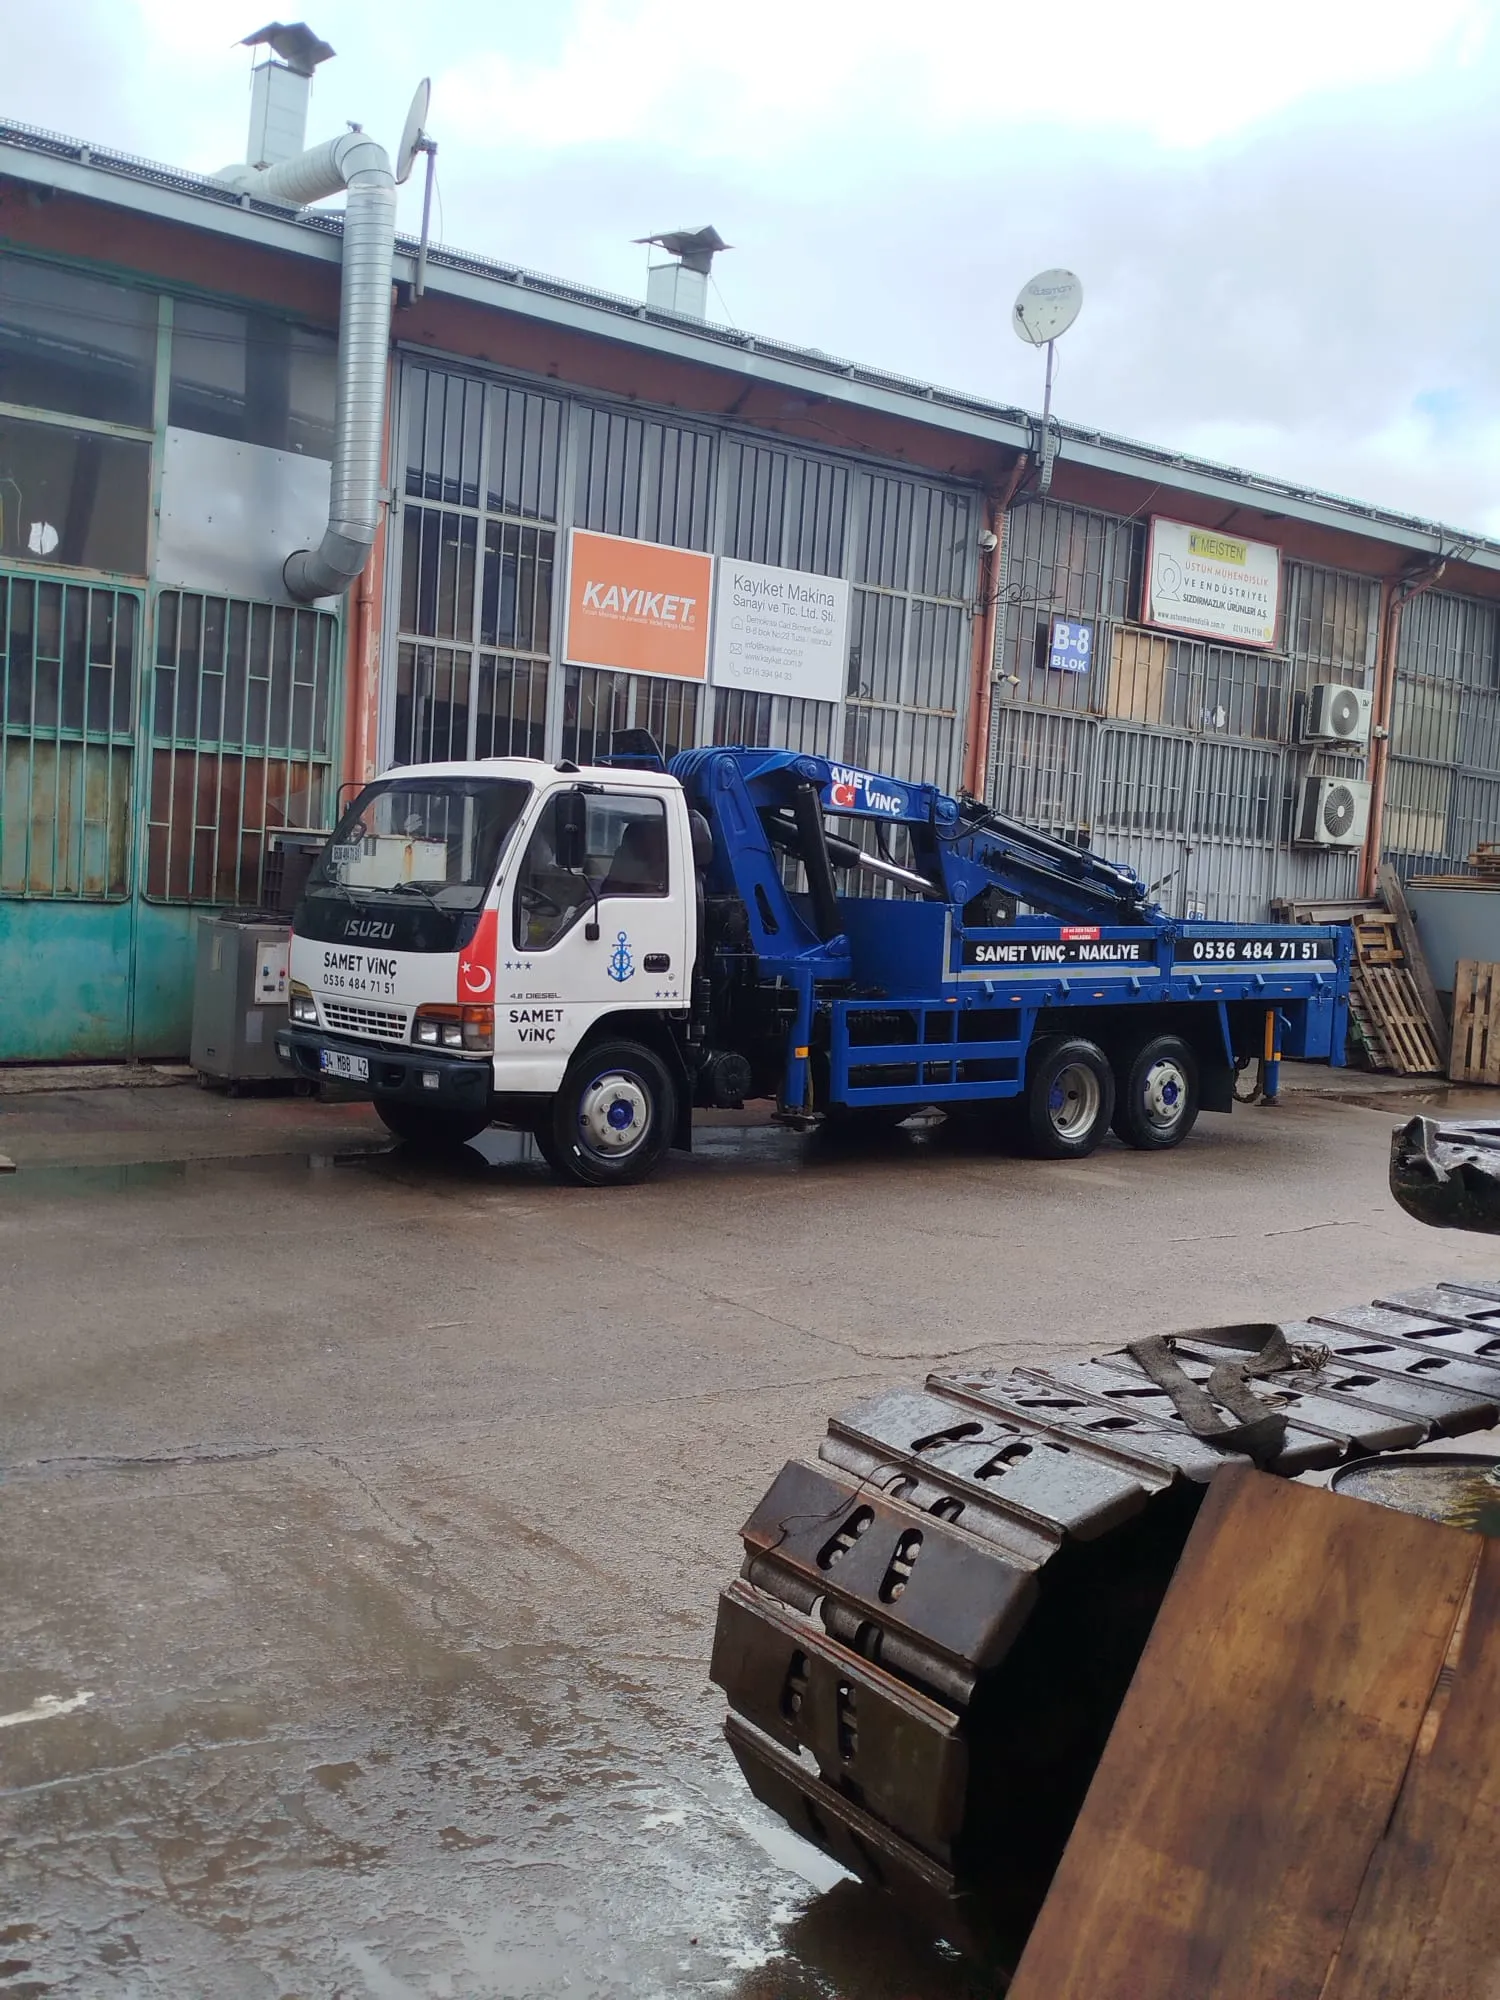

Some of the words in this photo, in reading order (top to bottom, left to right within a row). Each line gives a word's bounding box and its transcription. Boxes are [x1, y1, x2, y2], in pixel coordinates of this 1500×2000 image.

[1184, 577, 1197, 588] VE
[582, 580, 697, 623] KAYIKET
[788, 583, 835, 607] Makina
[733, 594, 765, 612] Sanayi
[768, 603, 779, 613] ve
[782, 602, 798, 617] Tic.
[801, 606, 818, 620] Ltd.
[821, 609, 836, 622] Şti.
[1053, 623, 1090, 654] B-8
[1052, 655, 1088, 671] BLOK
[831, 767, 874, 790] AMET
[344, 919, 395, 939] ISUZU
[975, 945, 1027, 962] SAMET
[1193, 941, 1236, 960] 0536
[1242, 941, 1273, 959] 484
[1280, 942, 1296, 959] 71
[1301, 942, 1318, 959] 51
[324, 951, 363, 972] SAMET
[323, 973, 345, 988] 0536
[348, 977, 366, 991] 484
[370, 980, 380, 993] 71
[384, 982, 395, 995] 51
[509, 1009, 564, 1024] SAMET
[325, 1051, 334, 1069] 34
[357, 1058, 368, 1076] 42
